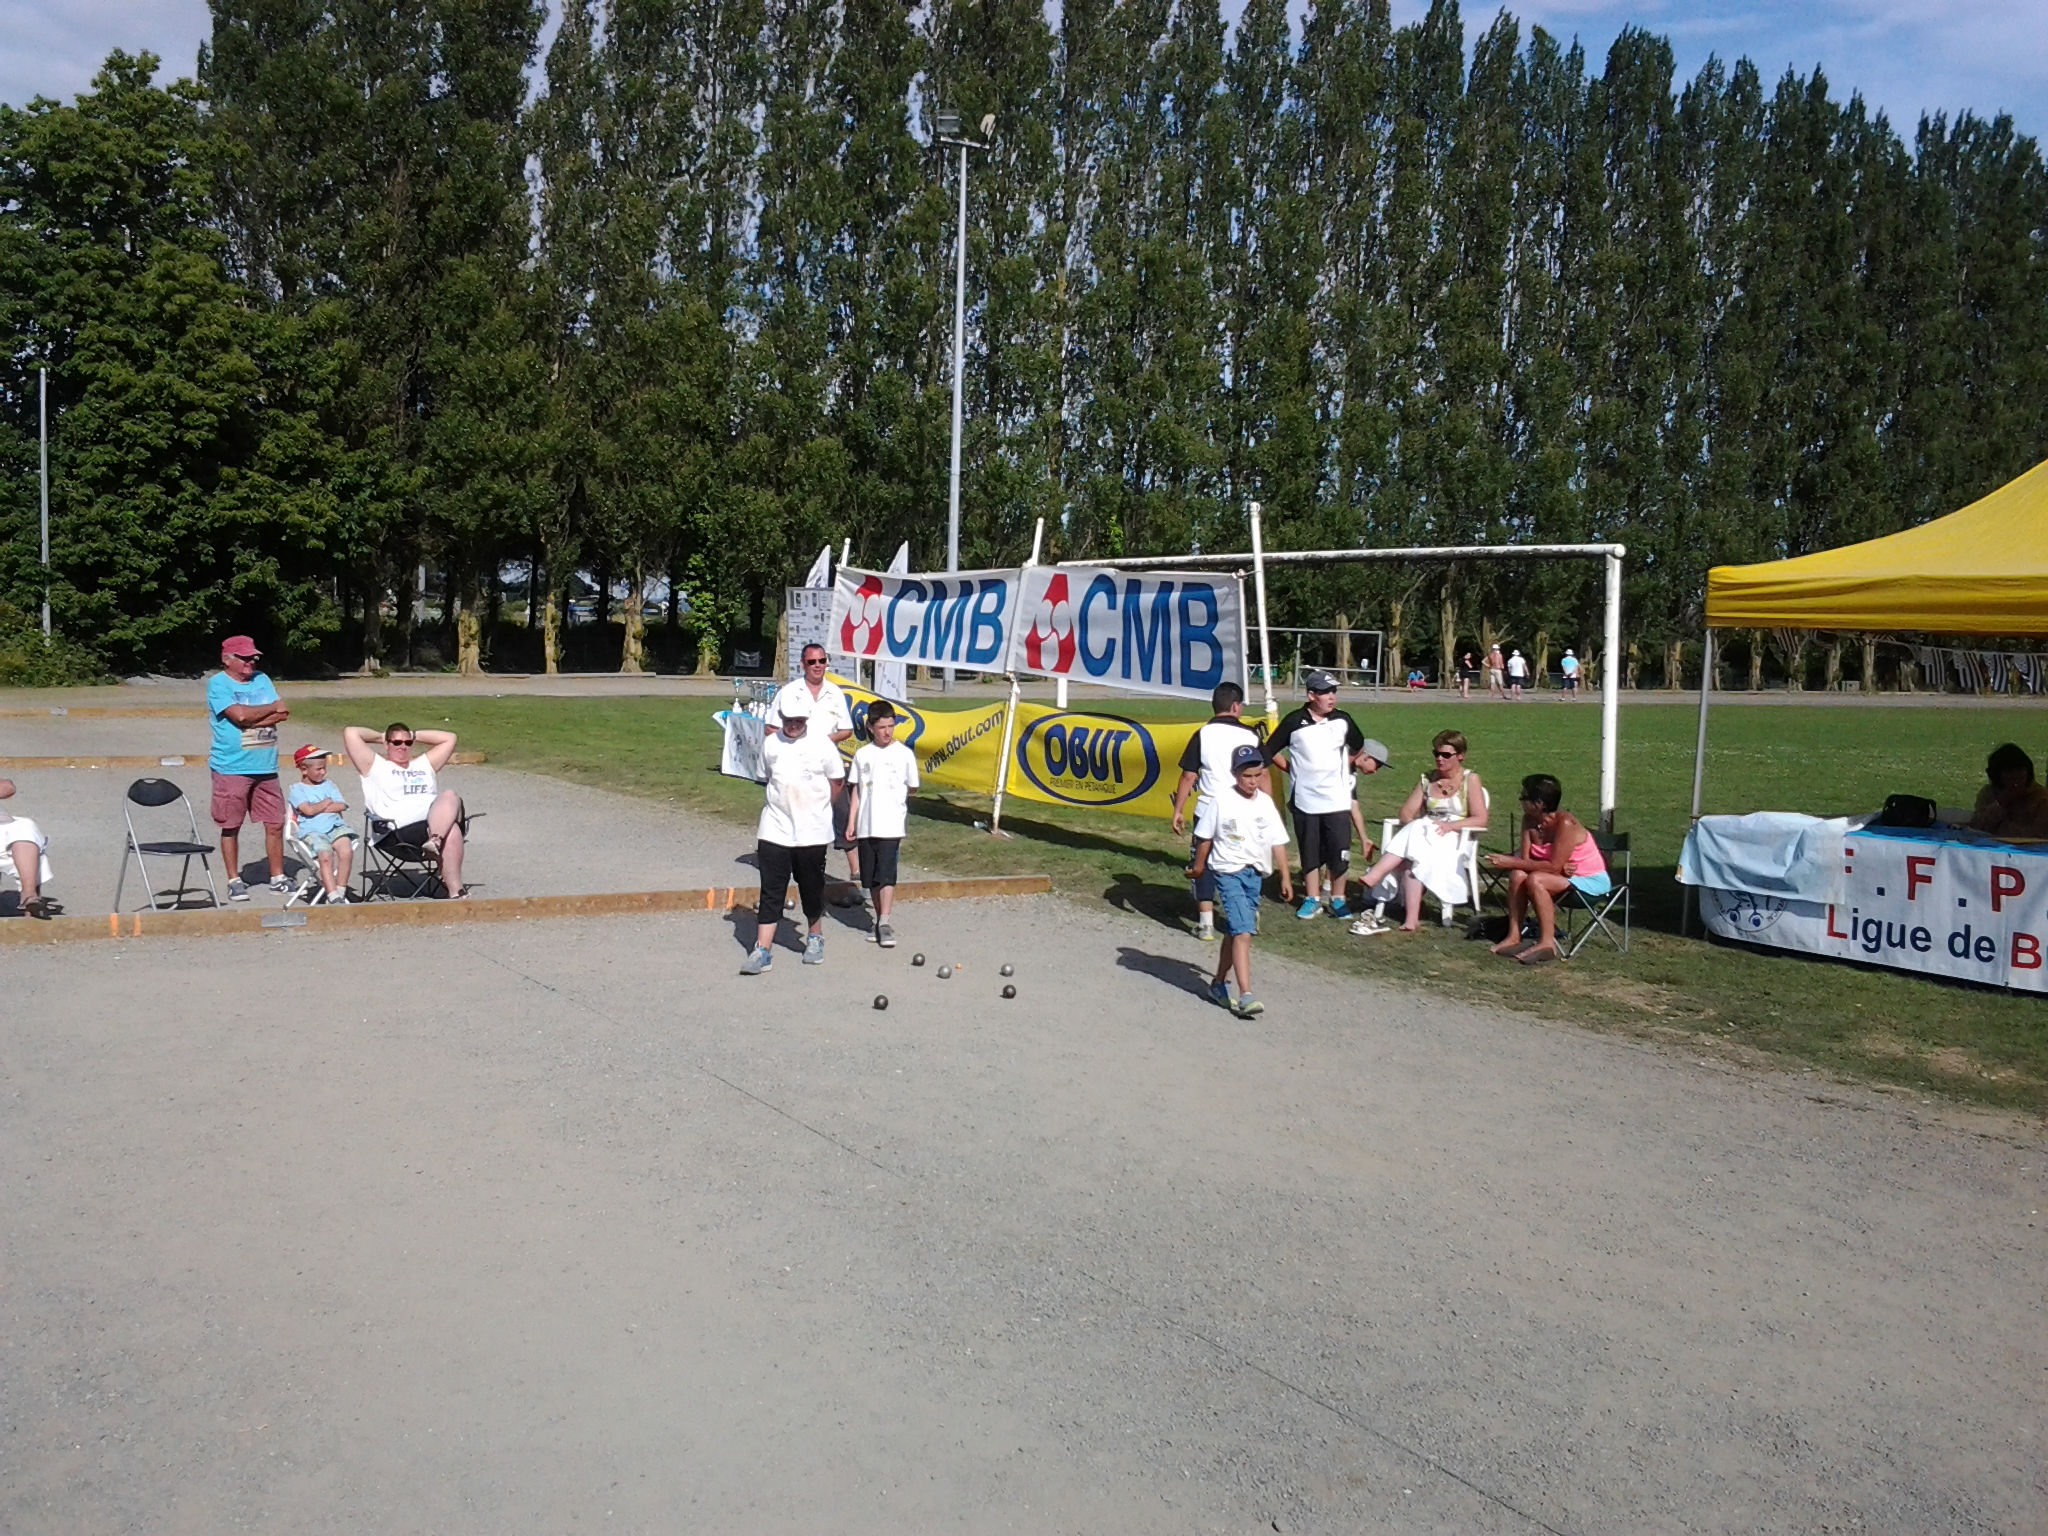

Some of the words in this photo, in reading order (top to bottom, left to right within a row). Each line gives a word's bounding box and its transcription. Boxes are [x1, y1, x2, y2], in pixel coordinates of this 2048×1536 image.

[886, 578, 1008, 665] CMB
[1078, 573, 1224, 690] CMB
[924, 709, 1005, 774] www.obut.com
[1043, 723, 1132, 784] OBUT
[403, 784, 428, 795] LIFE
[1827, 904, 1932, 954] Ligue
[1947, 923, 1996, 963] de
